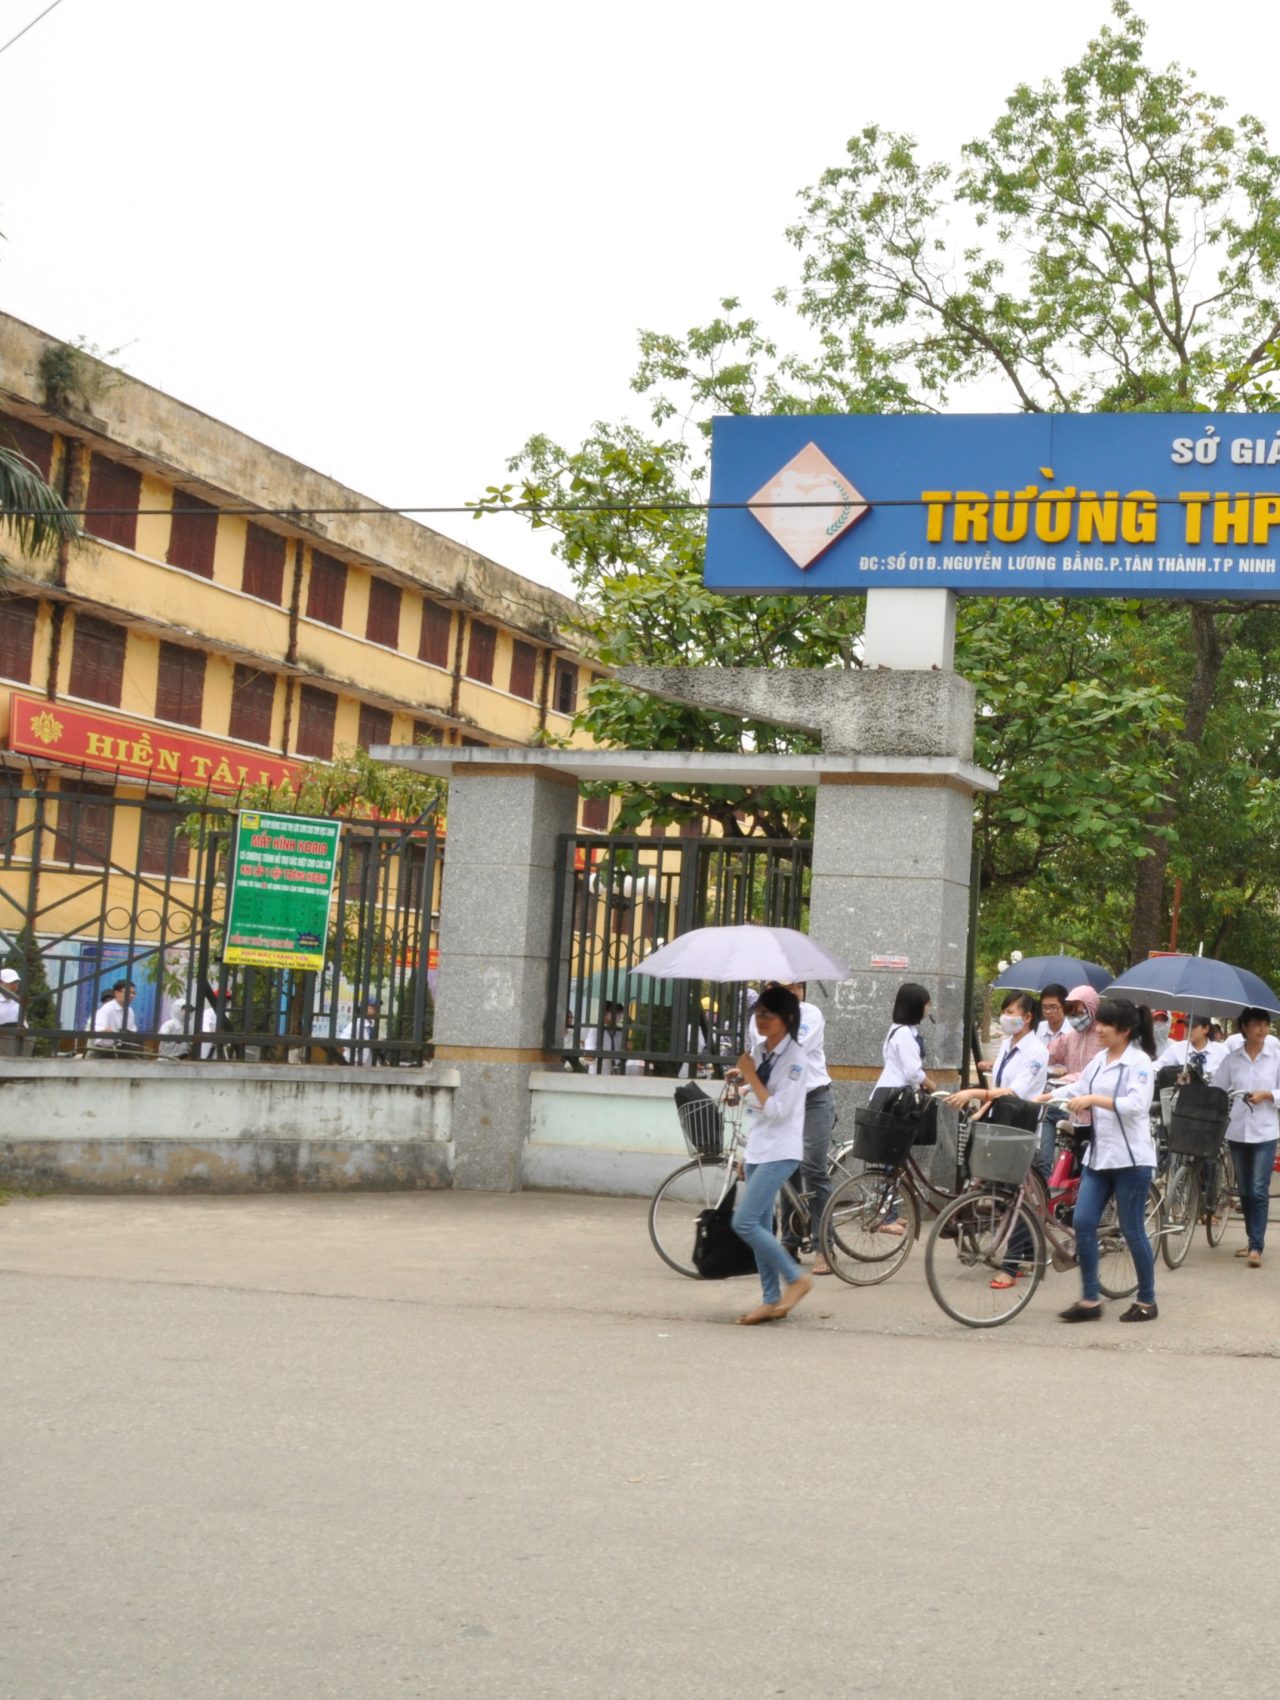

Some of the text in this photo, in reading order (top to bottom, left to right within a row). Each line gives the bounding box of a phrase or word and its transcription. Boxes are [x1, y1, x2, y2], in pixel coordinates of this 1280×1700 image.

[1170, 426, 1221, 464] SỞ
[921, 467, 1158, 543] TRƯỜNG
[1007, 555, 1057, 572] LƯƠNG
[1238, 557, 1276, 573] NINH
[86, 732, 181, 773] HIỀN
[190, 756, 251, 787] TÀI
